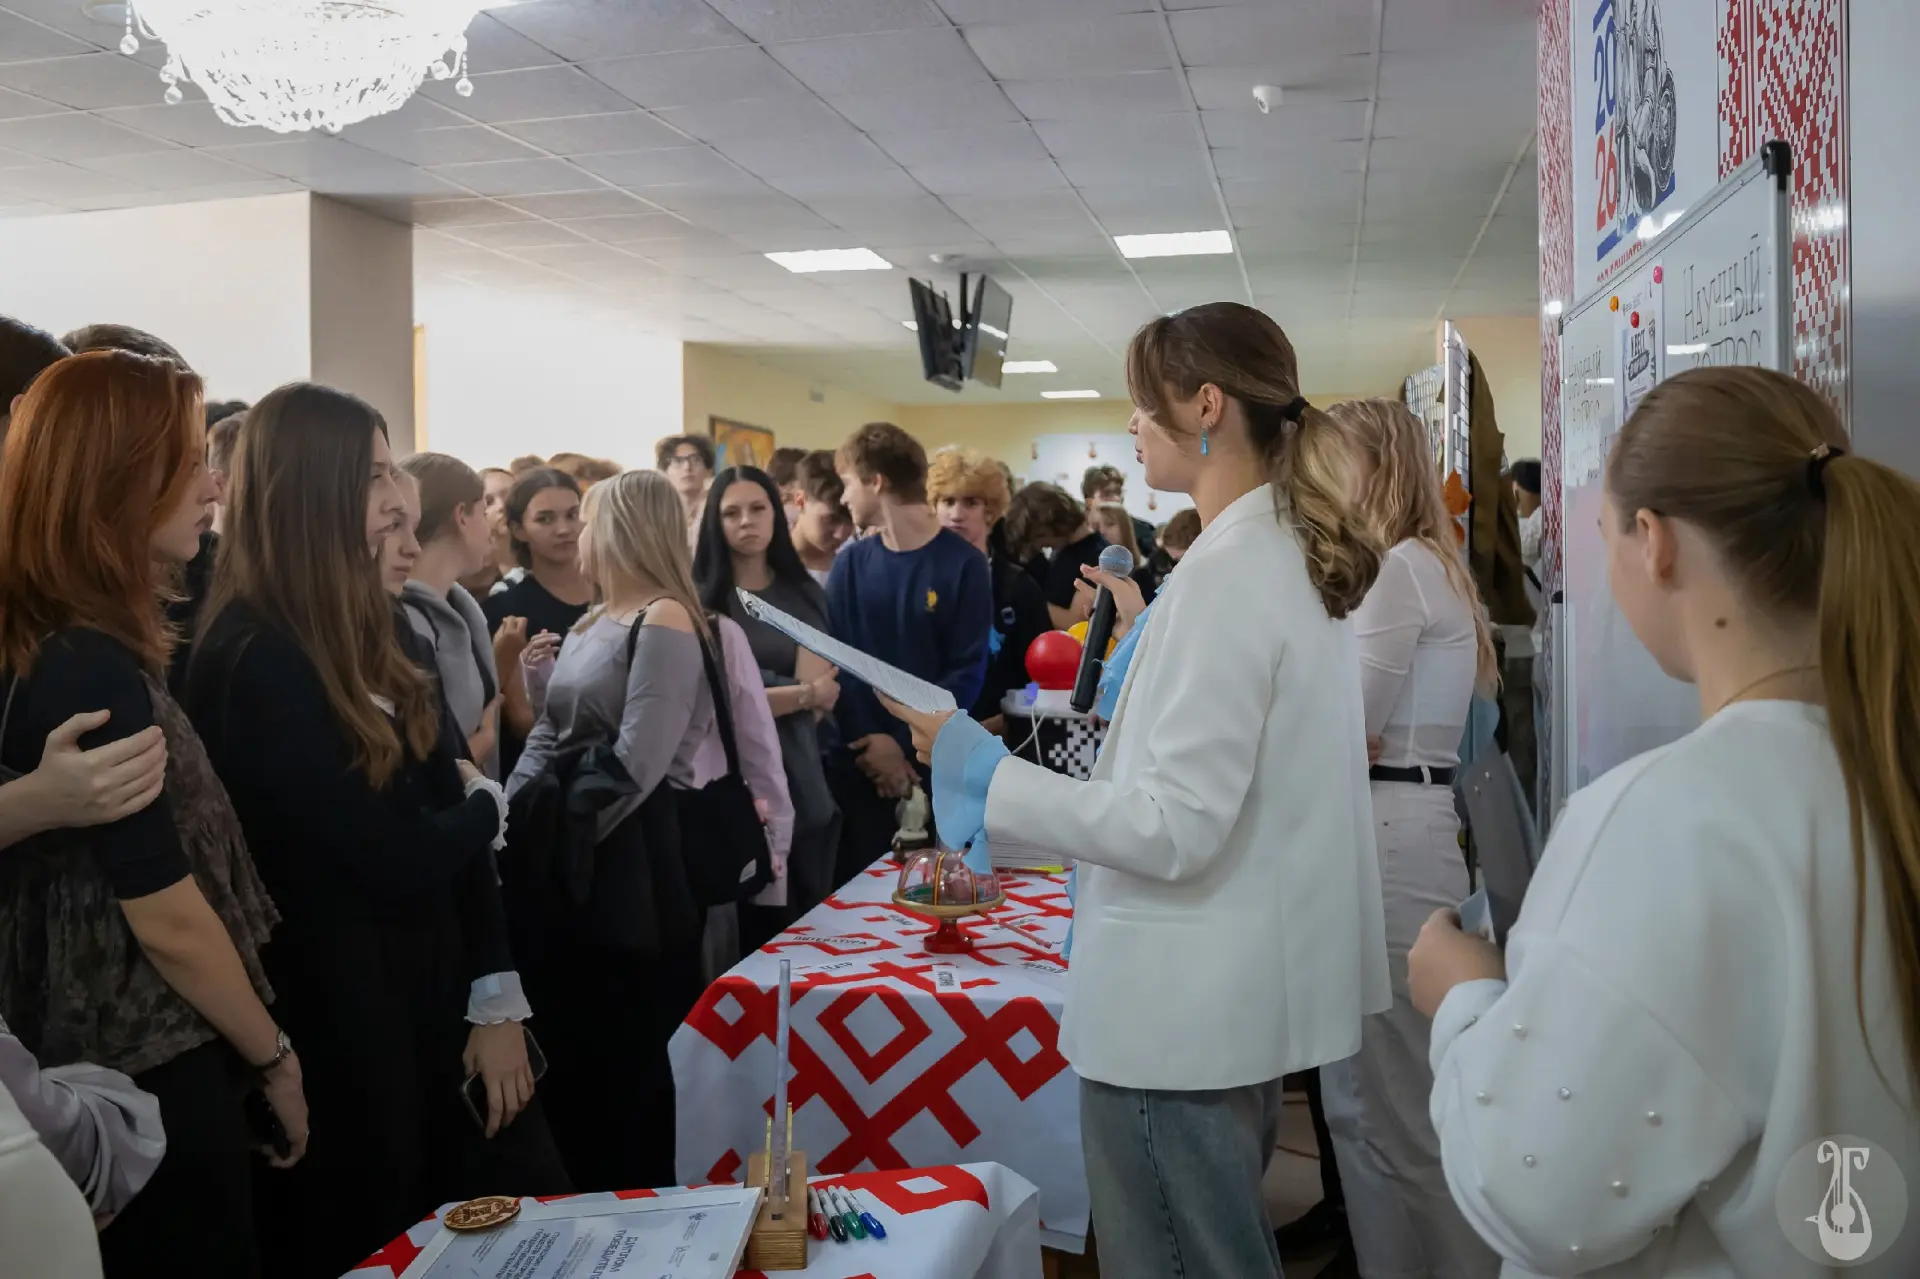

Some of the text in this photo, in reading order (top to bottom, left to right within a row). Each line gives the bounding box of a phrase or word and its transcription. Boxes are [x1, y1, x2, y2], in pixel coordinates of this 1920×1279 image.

[1594, 15, 1617, 136] 20
[1595, 118, 1618, 232] 26
[609, 1236, 638, 1273] ДИПЛОМ
